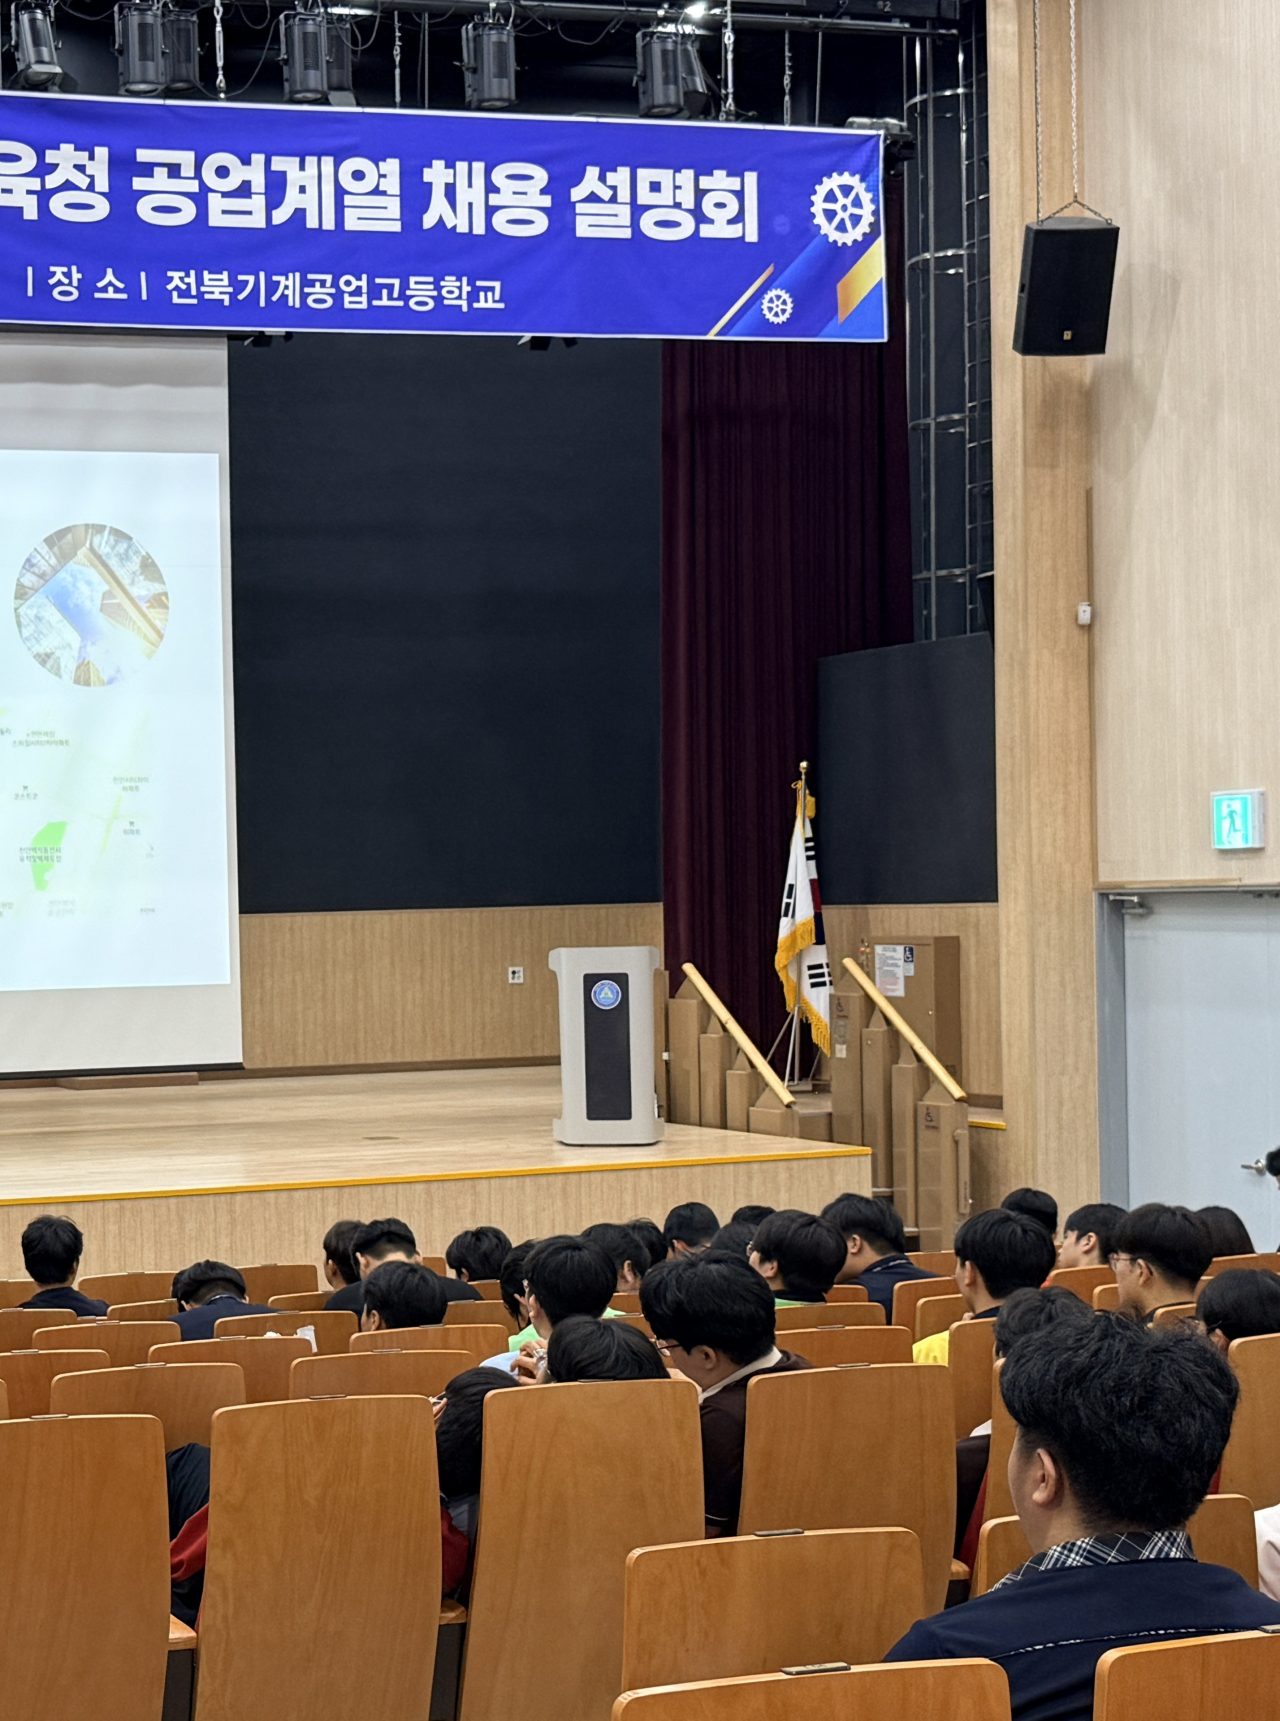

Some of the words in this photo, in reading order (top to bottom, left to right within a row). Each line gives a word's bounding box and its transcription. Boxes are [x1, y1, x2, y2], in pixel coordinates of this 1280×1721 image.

[133, 149, 401, 232] 공업계열
[423, 160, 551, 236] 채용
[571, 166, 758, 242] 설명회
[48, 266, 82, 301] 장
[94, 268, 127, 299] 소
[166, 270, 504, 312] 전북기계공업고등학교
